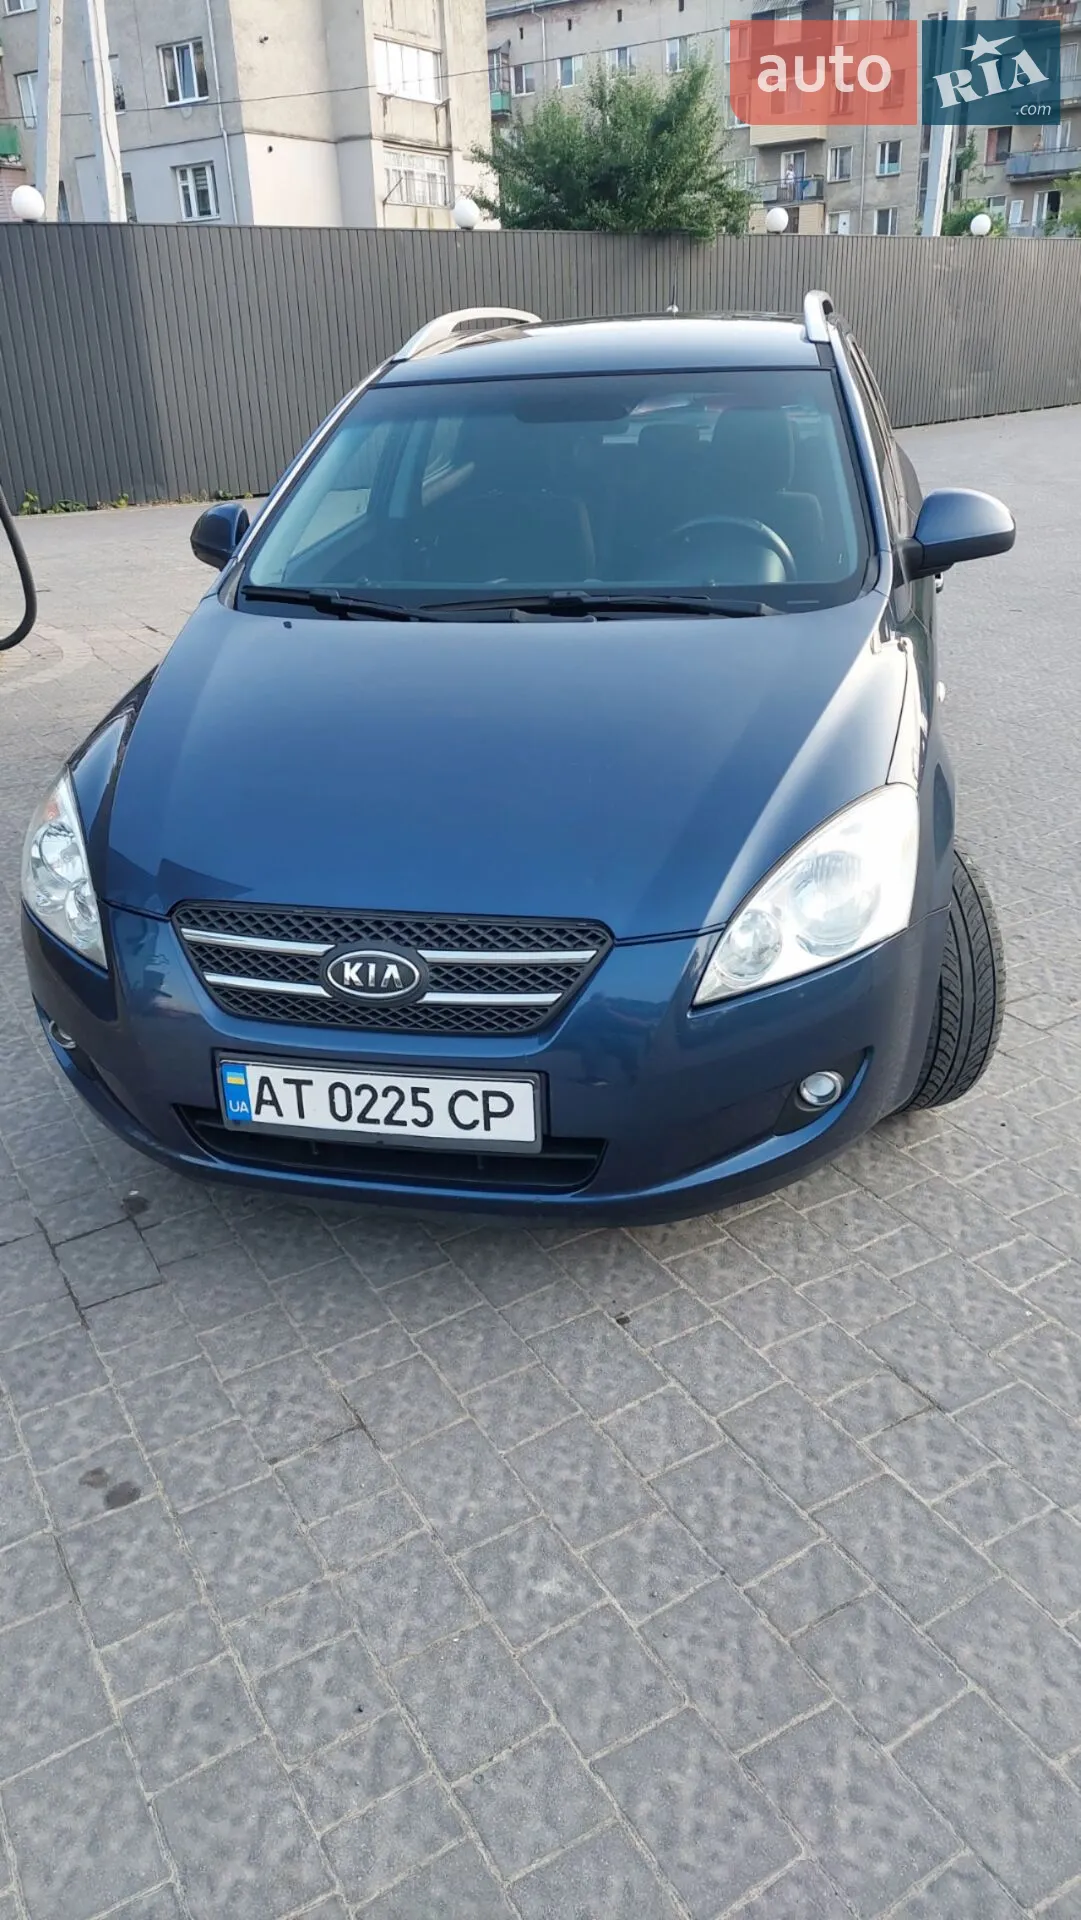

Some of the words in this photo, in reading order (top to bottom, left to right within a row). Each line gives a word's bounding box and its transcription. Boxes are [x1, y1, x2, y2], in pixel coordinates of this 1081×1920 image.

[343, 961, 403, 988] KIA
[229, 1100, 249, 1114] UA
[254, 1076, 314, 1119] AT
[328, 1081, 434, 1128] 0225
[448, 1089, 515, 1131] CP
